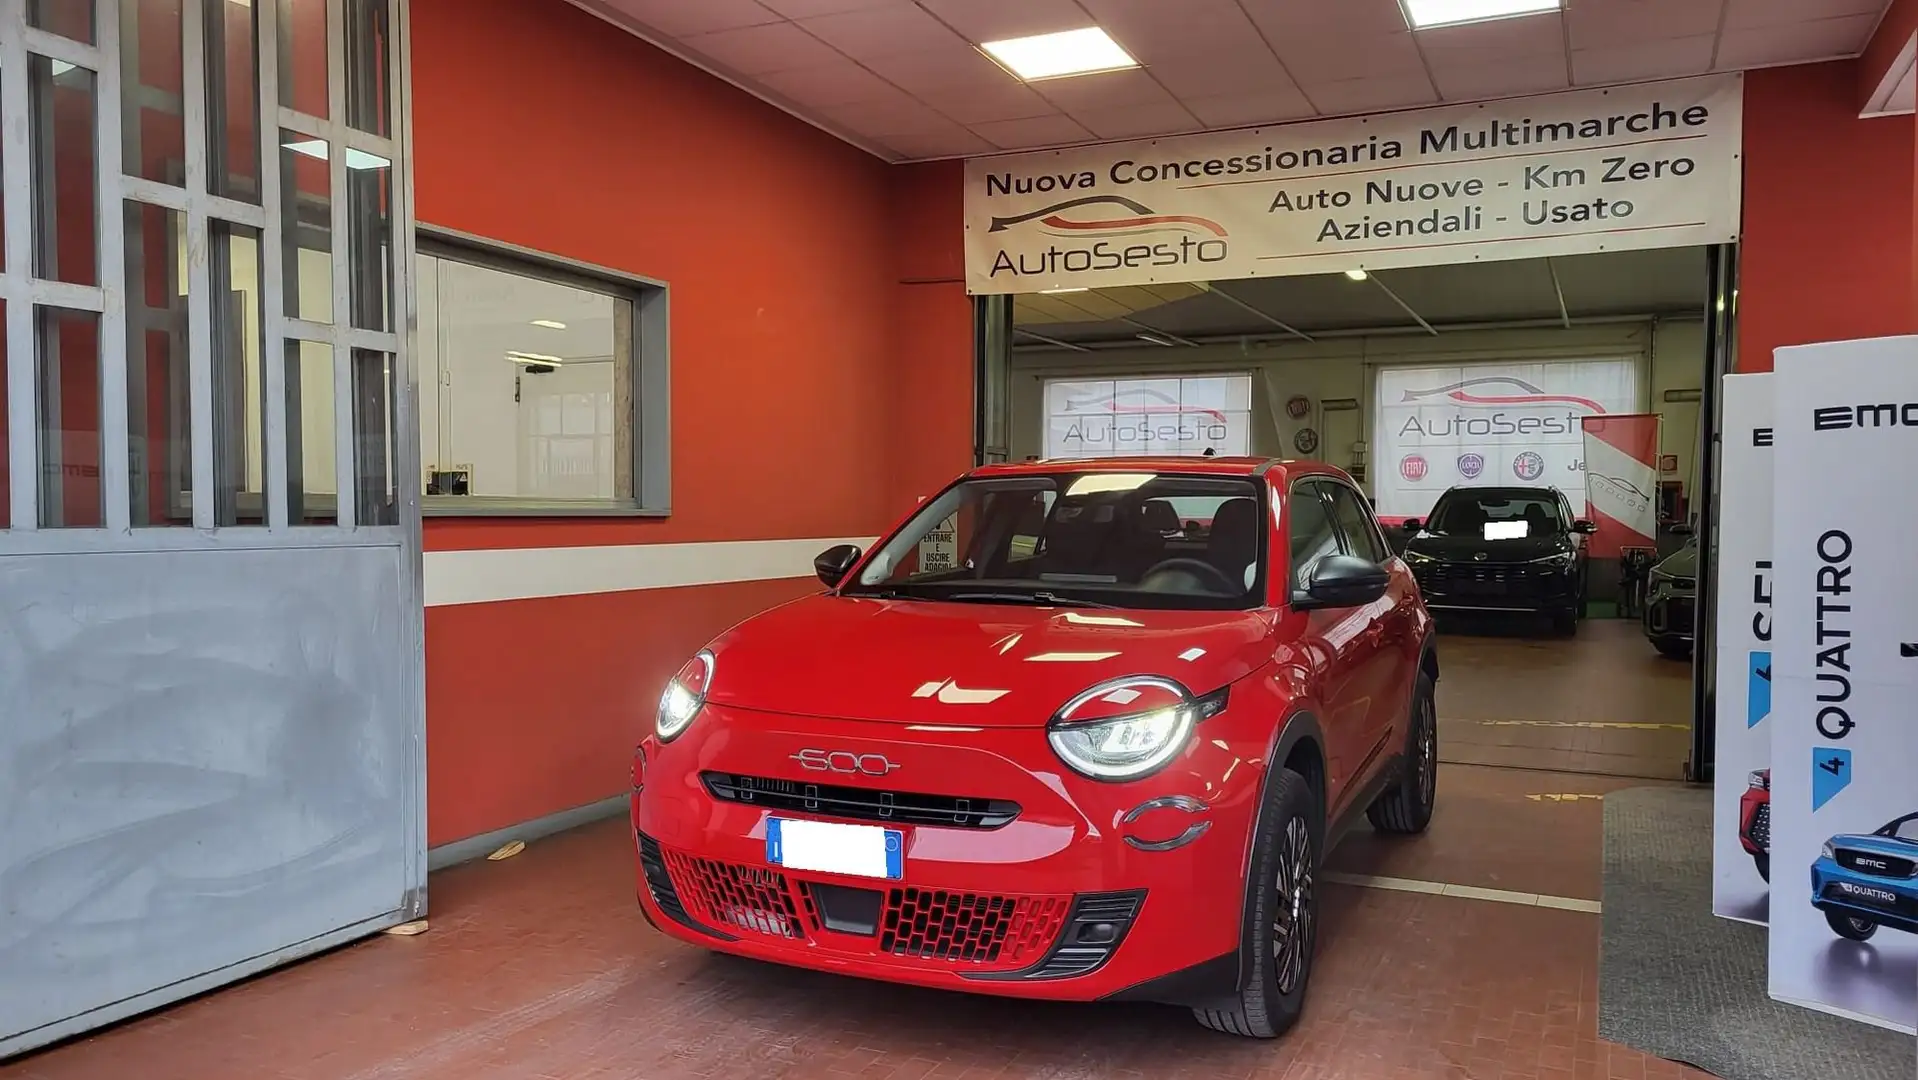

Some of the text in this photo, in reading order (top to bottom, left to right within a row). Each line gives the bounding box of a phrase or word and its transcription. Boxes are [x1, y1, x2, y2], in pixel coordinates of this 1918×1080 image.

[986, 102, 1709, 197] Nuova Concessionaria Multimarche
[1268, 189, 1351, 213] Auto
[1366, 178, 1484, 205] Nuove
[1524, 164, 1586, 191] Km
[1601, 156, 1695, 183] Zero
[1316, 206, 1482, 243] Aziendali
[1523, 198, 1634, 226] Usato
[990, 235, 1228, 278] AutoSesto
[1063, 416, 1227, 443] AutoSesto
[1567, 458, 1586, 471] Je
[924, 533, 953, 543] ENTRARE
[935, 543, 940, 552] E
[926, 553, 950, 562] USCIRE
[1816, 529, 1855, 776] 4 QUATTRO
[1853, 885, 1896, 902] QUATTRO
